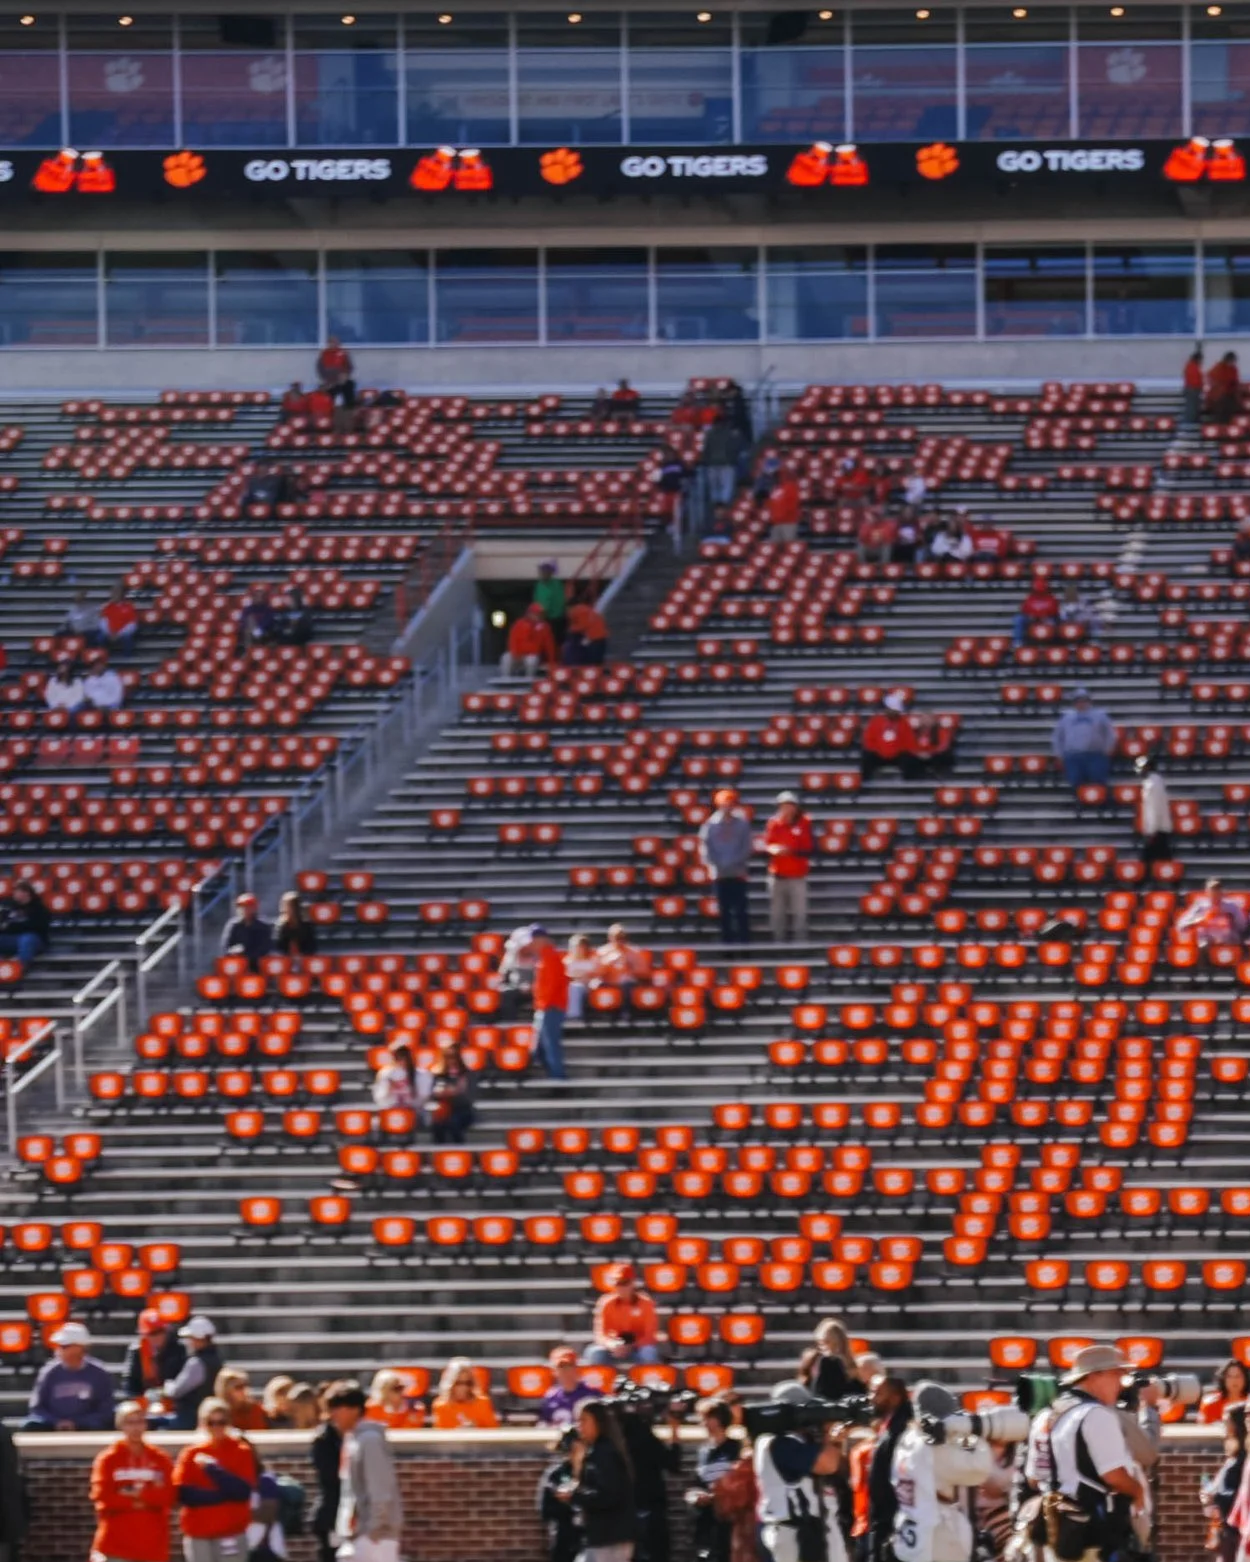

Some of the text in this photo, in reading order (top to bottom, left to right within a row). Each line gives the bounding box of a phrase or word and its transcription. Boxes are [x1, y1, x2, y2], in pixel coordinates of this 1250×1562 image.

[244, 158, 391, 181] GO TIGERS
[620, 154, 768, 178] GO TIGERS
[996, 149, 1145, 172] GO TIGERS
